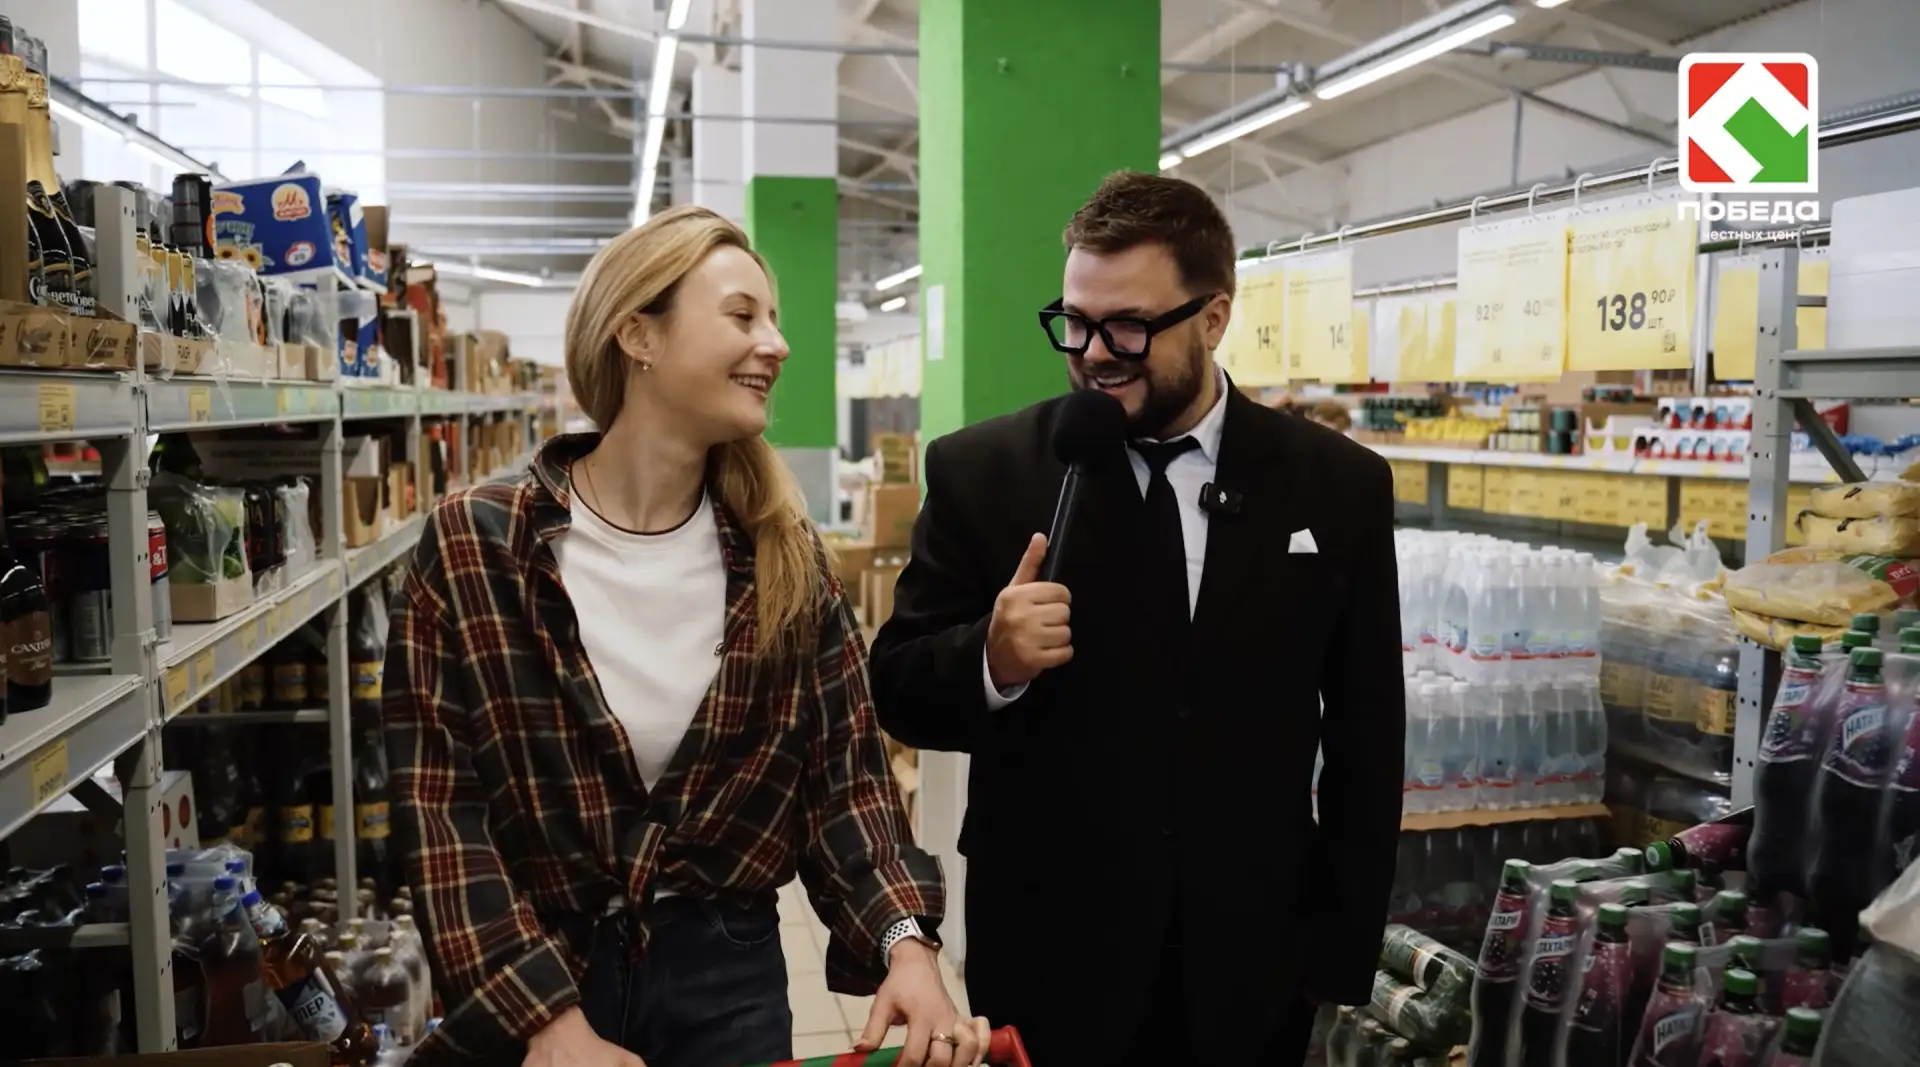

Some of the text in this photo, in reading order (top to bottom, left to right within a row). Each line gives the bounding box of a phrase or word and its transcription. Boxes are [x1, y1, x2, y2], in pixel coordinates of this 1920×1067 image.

[1597, 291, 1647, 332] 138
[1256, 325, 1270, 350] 14
[1329, 323, 1344, 349] 14
